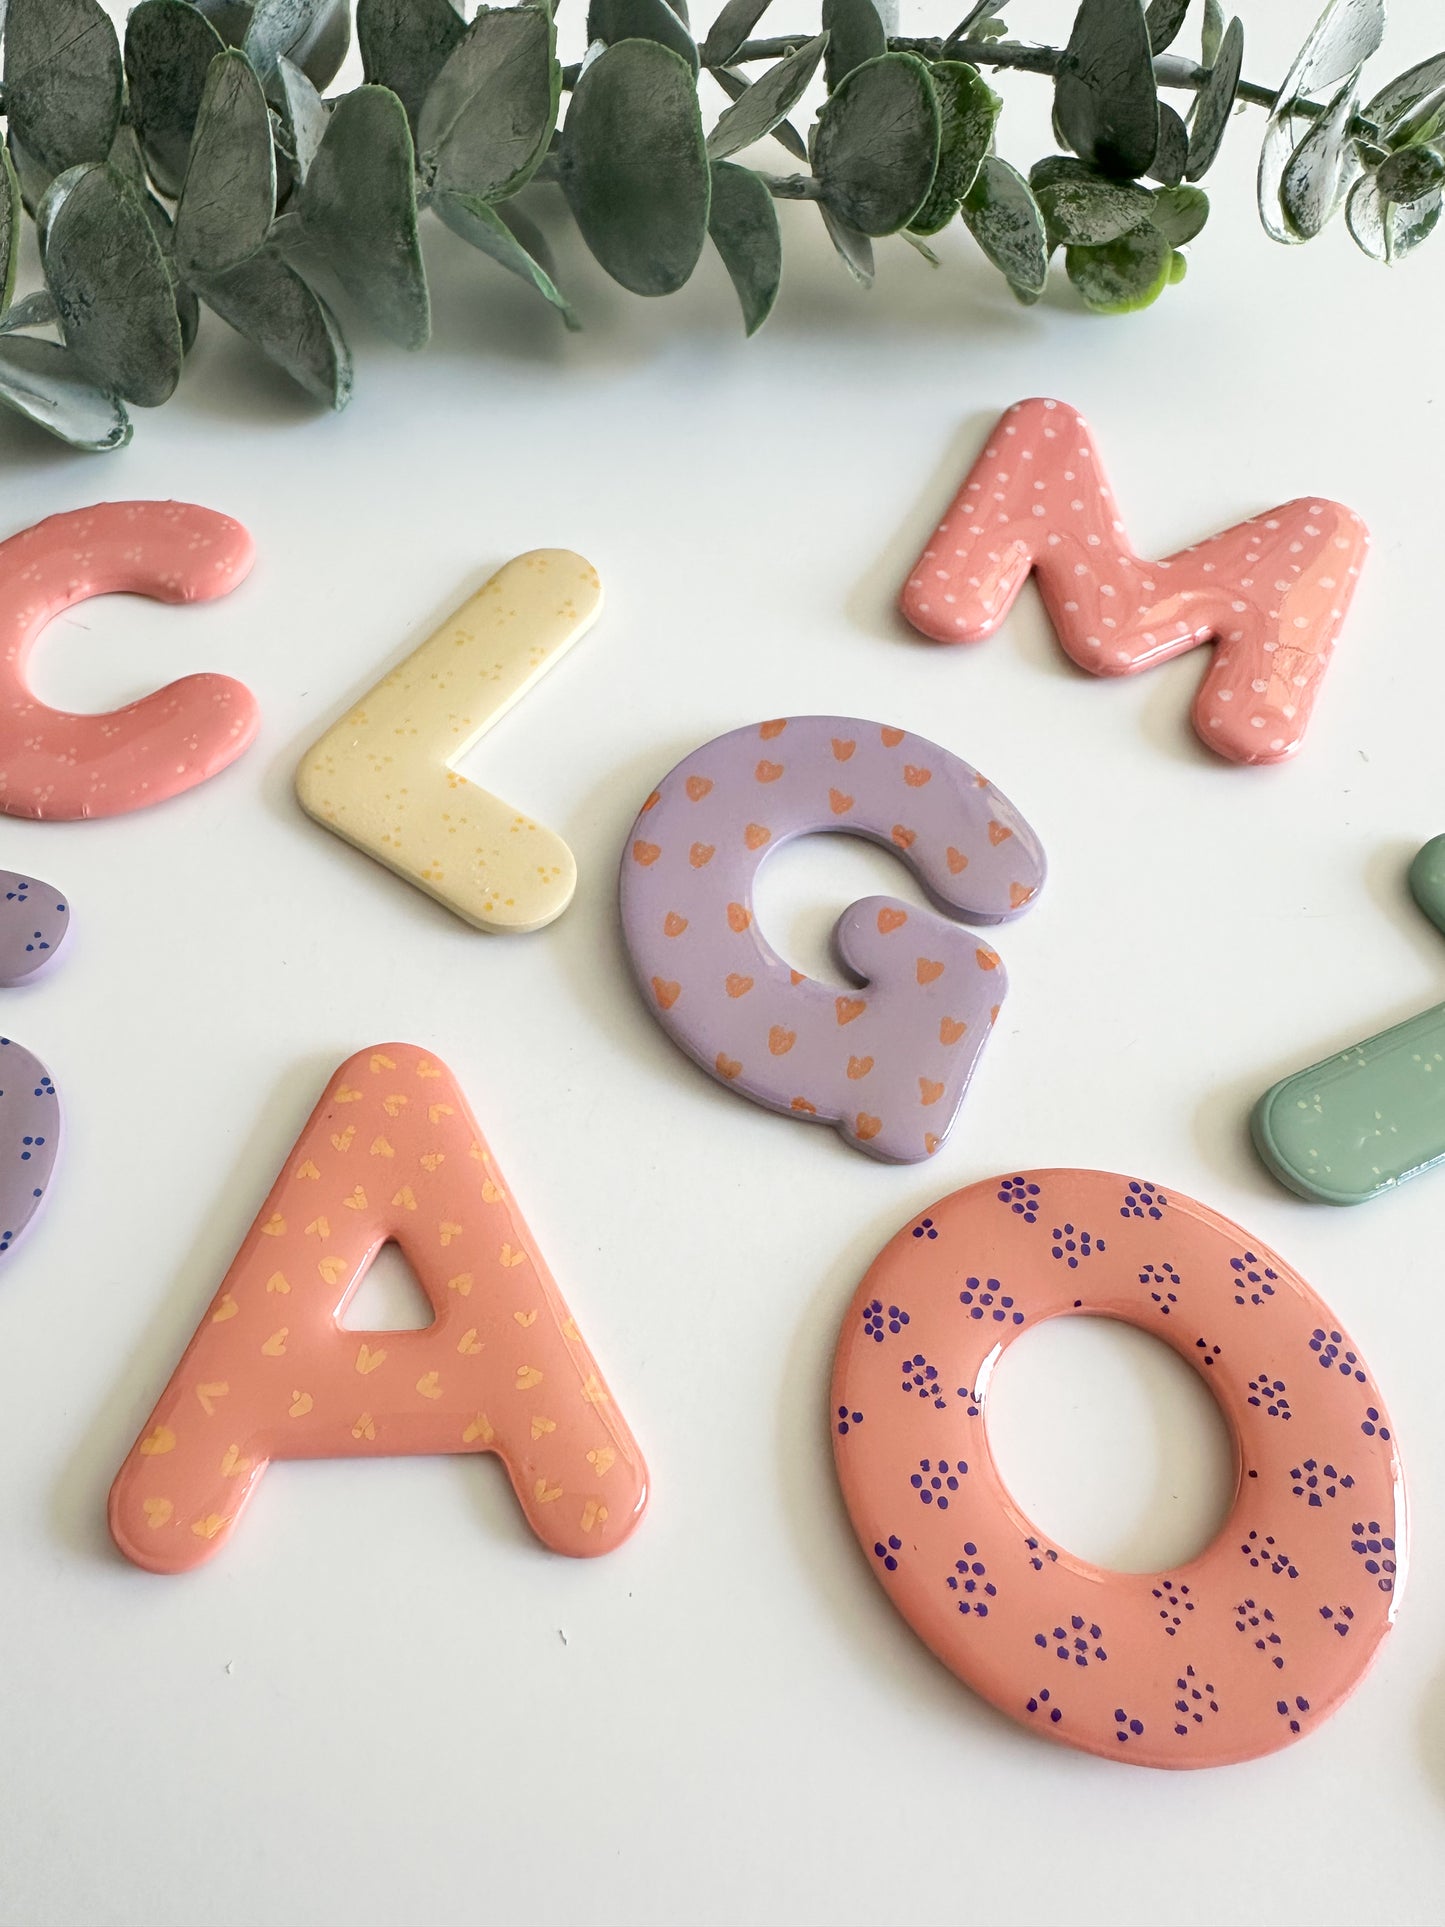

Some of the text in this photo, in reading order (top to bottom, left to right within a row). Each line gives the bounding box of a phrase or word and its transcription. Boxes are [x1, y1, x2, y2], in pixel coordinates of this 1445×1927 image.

[0, 500, 262, 821] C
[295, 548, 605, 934] L
[899, 397, 1372, 767] M
[619, 715, 1048, 1164] G
[108, 1042, 650, 1574] A
[831, 1168, 1407, 1770] O
